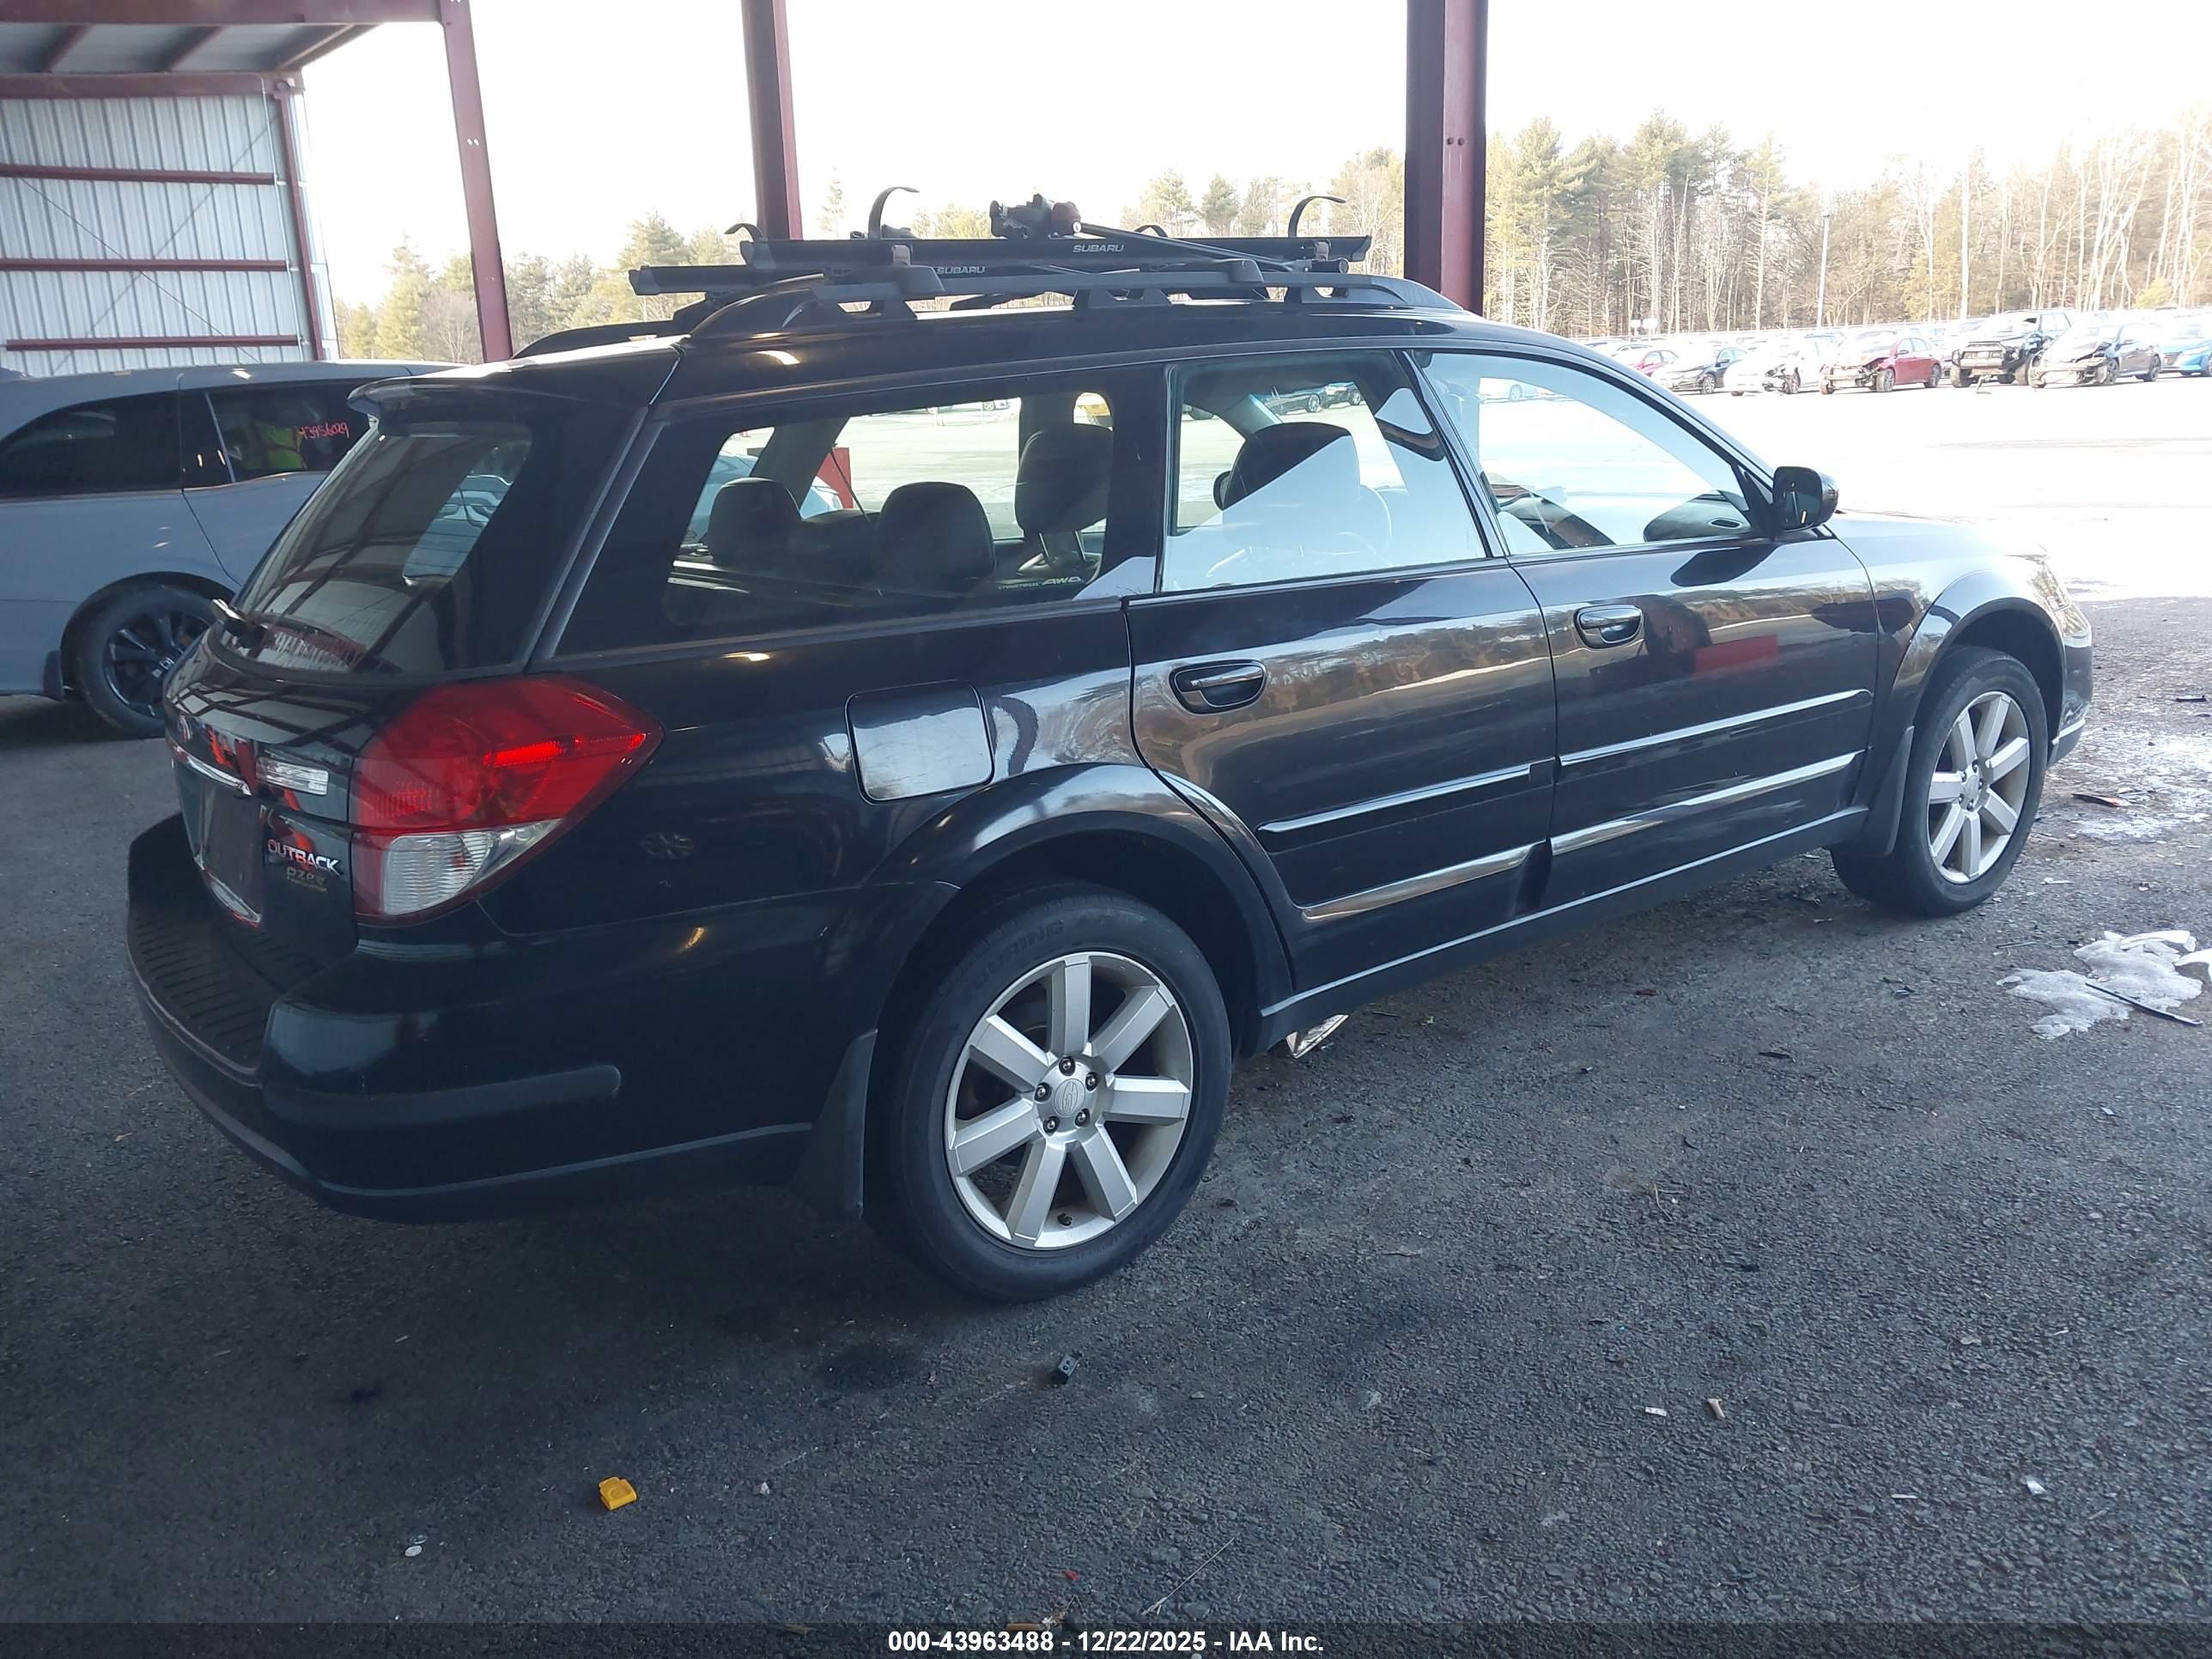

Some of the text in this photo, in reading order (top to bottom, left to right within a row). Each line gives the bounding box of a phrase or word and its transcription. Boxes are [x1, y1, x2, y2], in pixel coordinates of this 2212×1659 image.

[1073, 244, 1125, 252] SUBARU
[937, 265, 987, 274] SUBARU
[1042, 576, 1081, 586] AWD
[267, 839, 341, 877] OUTBACK
